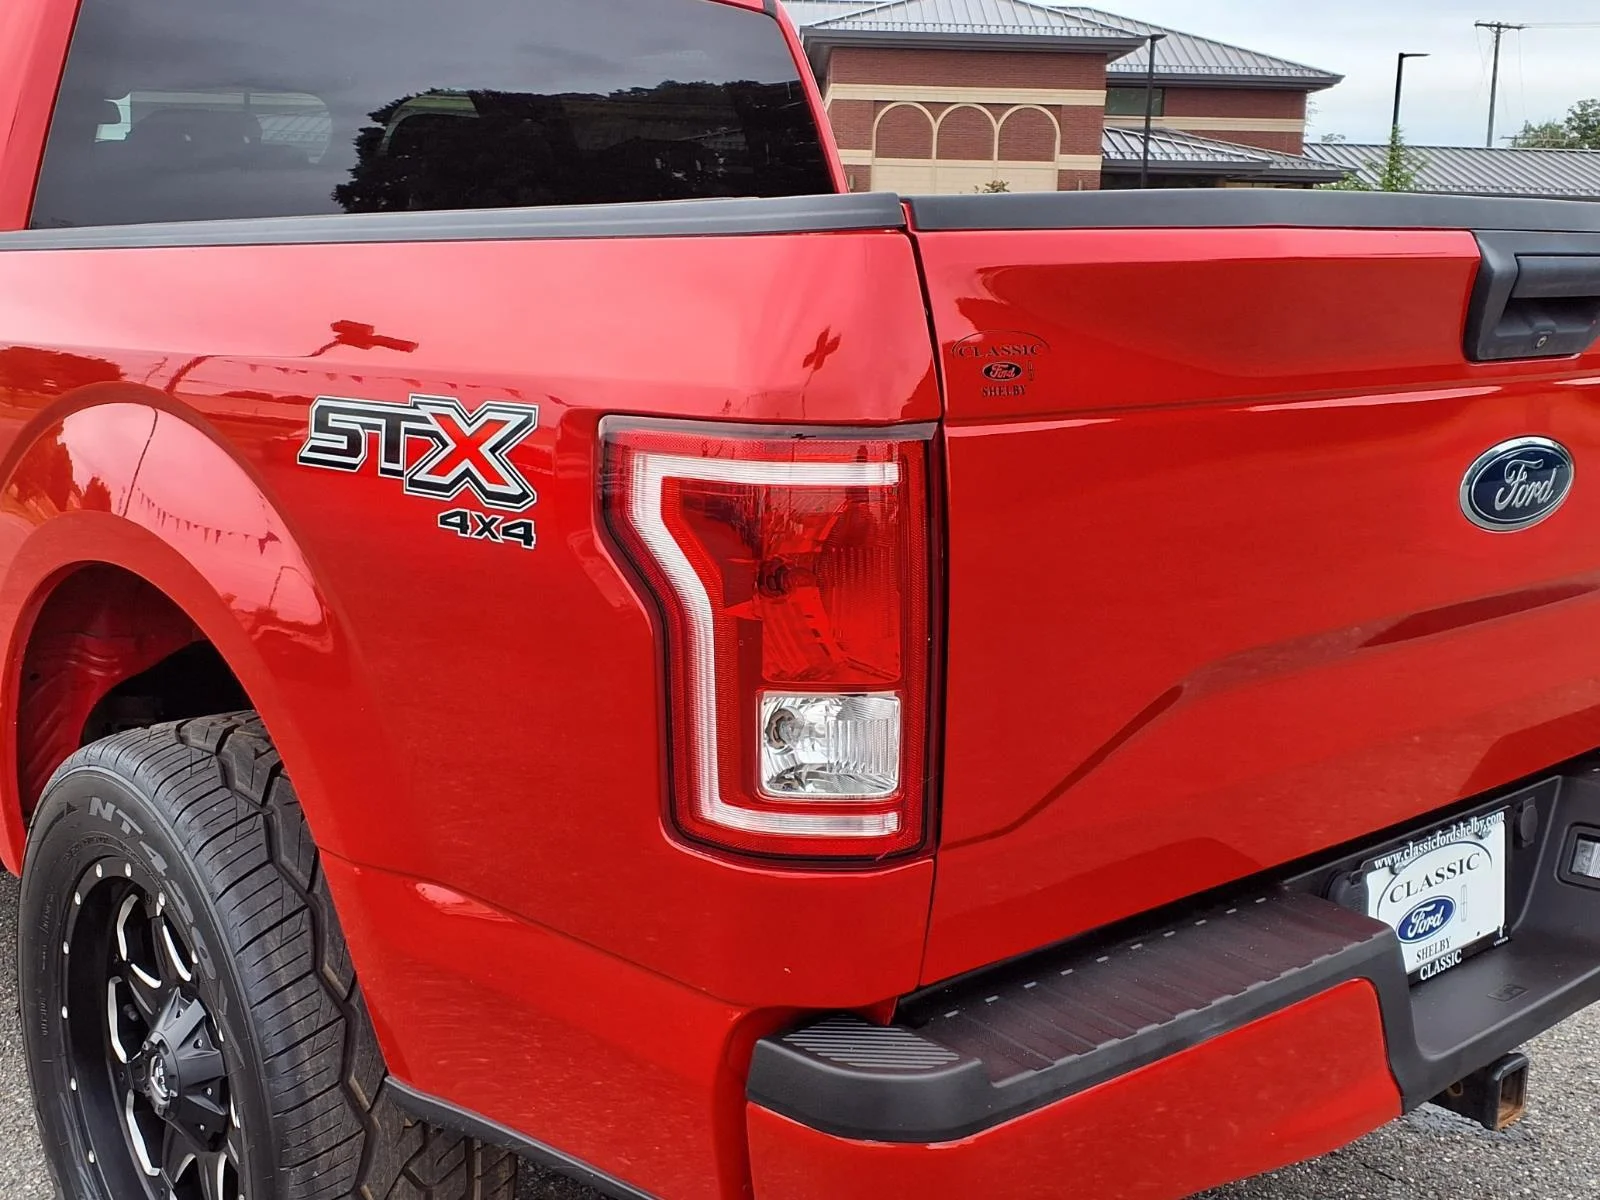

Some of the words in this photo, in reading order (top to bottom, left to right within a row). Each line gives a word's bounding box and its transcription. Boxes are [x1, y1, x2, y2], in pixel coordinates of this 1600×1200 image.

[958, 343, 1040, 357] CLASSIC
[989, 363, 1016, 378] Ford
[982, 384, 1026, 398] SHELBY
[297, 393, 539, 512] STX
[1494, 458, 1557, 511] Ford
[1374, 811, 1505, 869] www.classicfordshelby.com
[1389, 852, 1480, 903] CLASSIC
[1407, 903, 1445, 938] Ford
[1416, 936, 1452, 963] SHELBY
[1420, 949, 1463, 981] CLASSIC
